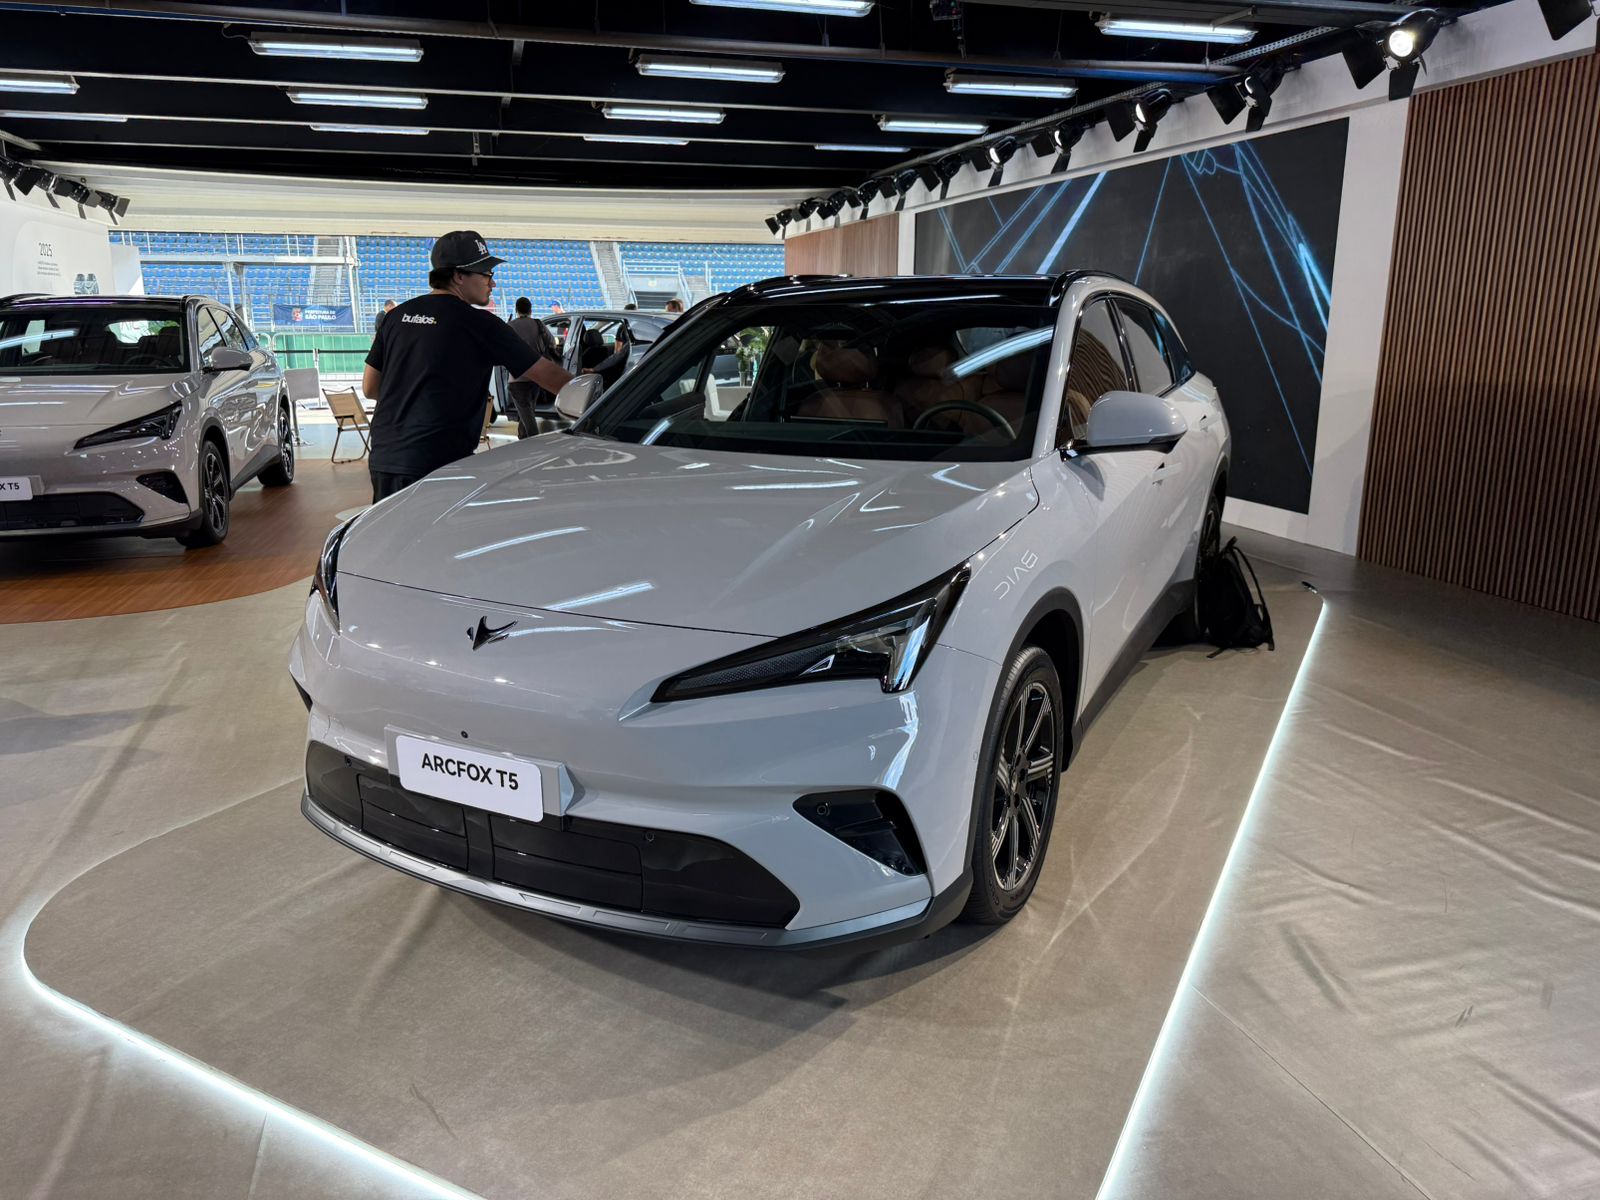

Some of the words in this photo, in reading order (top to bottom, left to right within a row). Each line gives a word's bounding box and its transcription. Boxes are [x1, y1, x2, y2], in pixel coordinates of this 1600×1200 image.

[38, 242, 53, 257] 2025
[475, 240, 487, 254] LA
[421, 752, 493, 785] ARCFOX
[495, 768, 519, 790] T5
